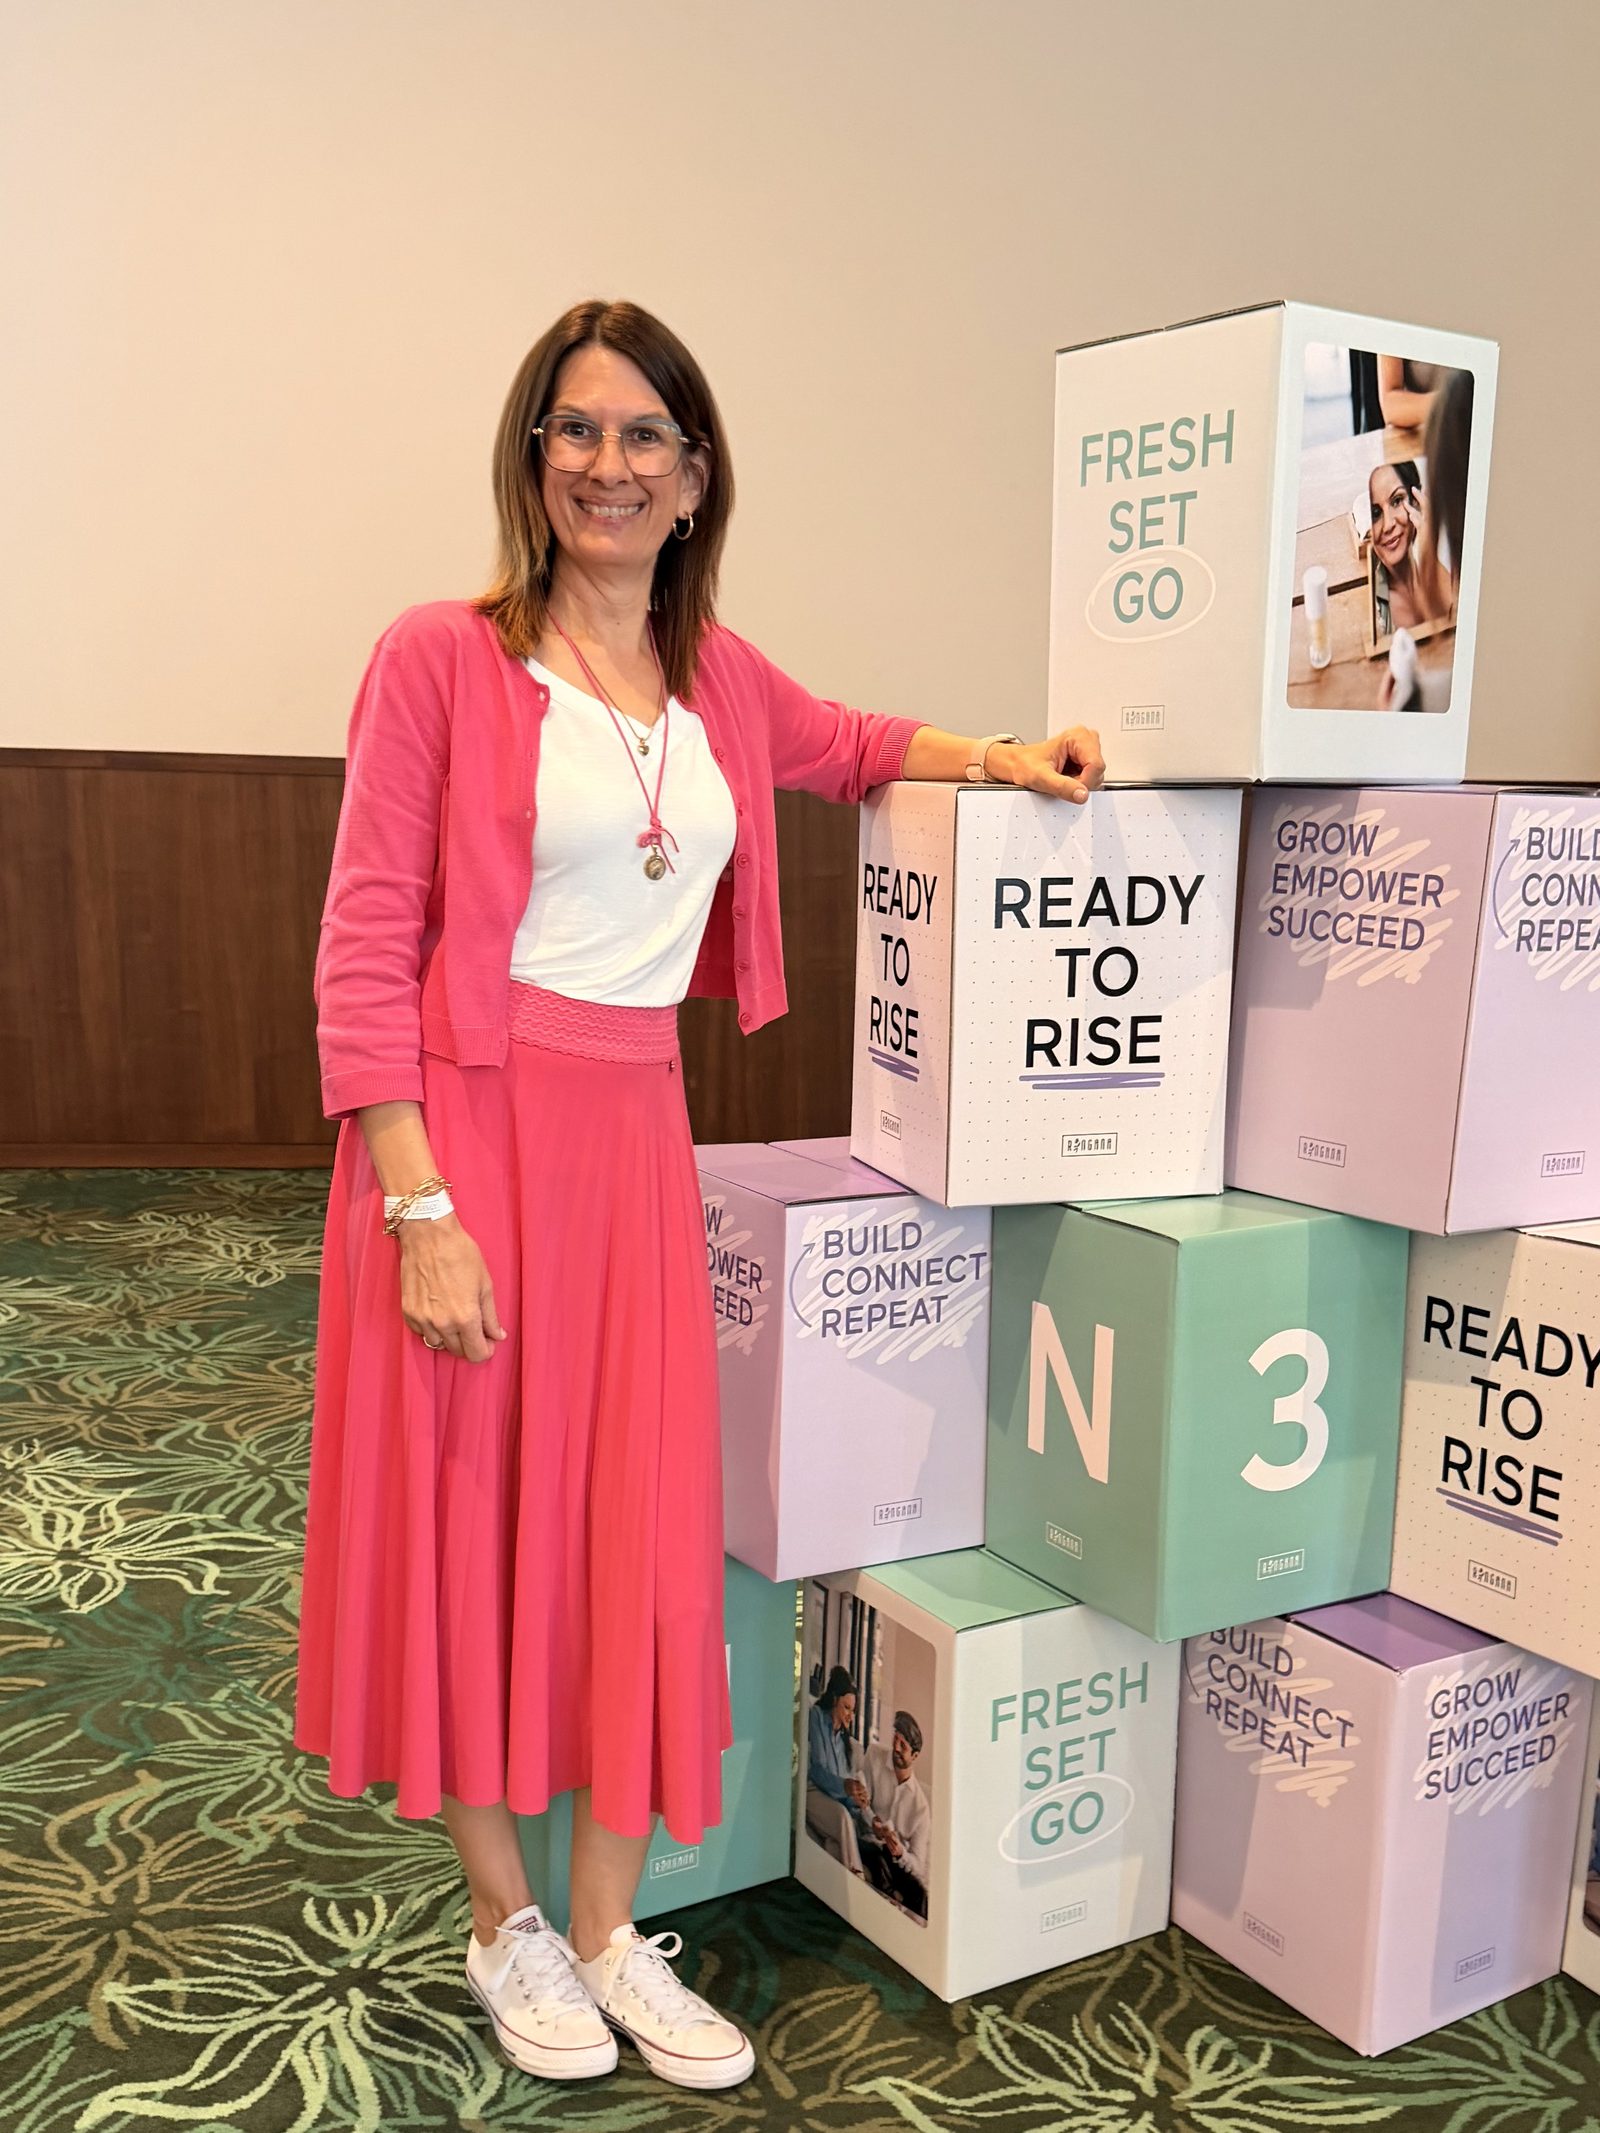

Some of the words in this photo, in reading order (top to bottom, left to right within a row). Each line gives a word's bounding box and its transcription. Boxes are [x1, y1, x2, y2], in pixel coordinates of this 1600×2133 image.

[1080, 410, 1235, 487] FRESH
[1108, 491, 1198, 554] SET
[1112, 566, 1184, 625] GO
[1277, 819, 1379, 857] GROW
[863, 863, 938, 925] READY
[993, 874, 1205, 929] READY
[1271, 863, 1444, 908] EMPOWER
[1268, 905, 1425, 951] SUCCEED
[880, 933, 910, 987] TO
[1055, 945, 1139, 999] TO
[869, 995, 919, 1059] RISE
[1024, 1014, 1163, 1068] RISE
[823, 1222, 922, 1260] BUILD
[821, 1252, 987, 1299] CONNECT
[821, 1295, 948, 1338] REPEAT
[1423, 1295, 1600, 1389] READY
[1027, 1300, 1114, 1484] N
[1240, 1328, 1329, 1492] 3
[1470, 1375, 1543, 1441] TO
[1441, 1435, 1563, 1522] RISE
[990, 1661, 1149, 1742] FRESH
[1207, 1653, 1354, 1748] CONNECT
[1430, 1668, 1521, 1719] GROW
[1206, 1688, 1314, 1767] REPEAT
[1427, 1693, 1570, 1761] EMPOWER
[1023, 1727, 1117, 1791] SET
[1424, 1734, 1556, 1800] SUCCEED
[1030, 1790, 1105, 1847] GO
